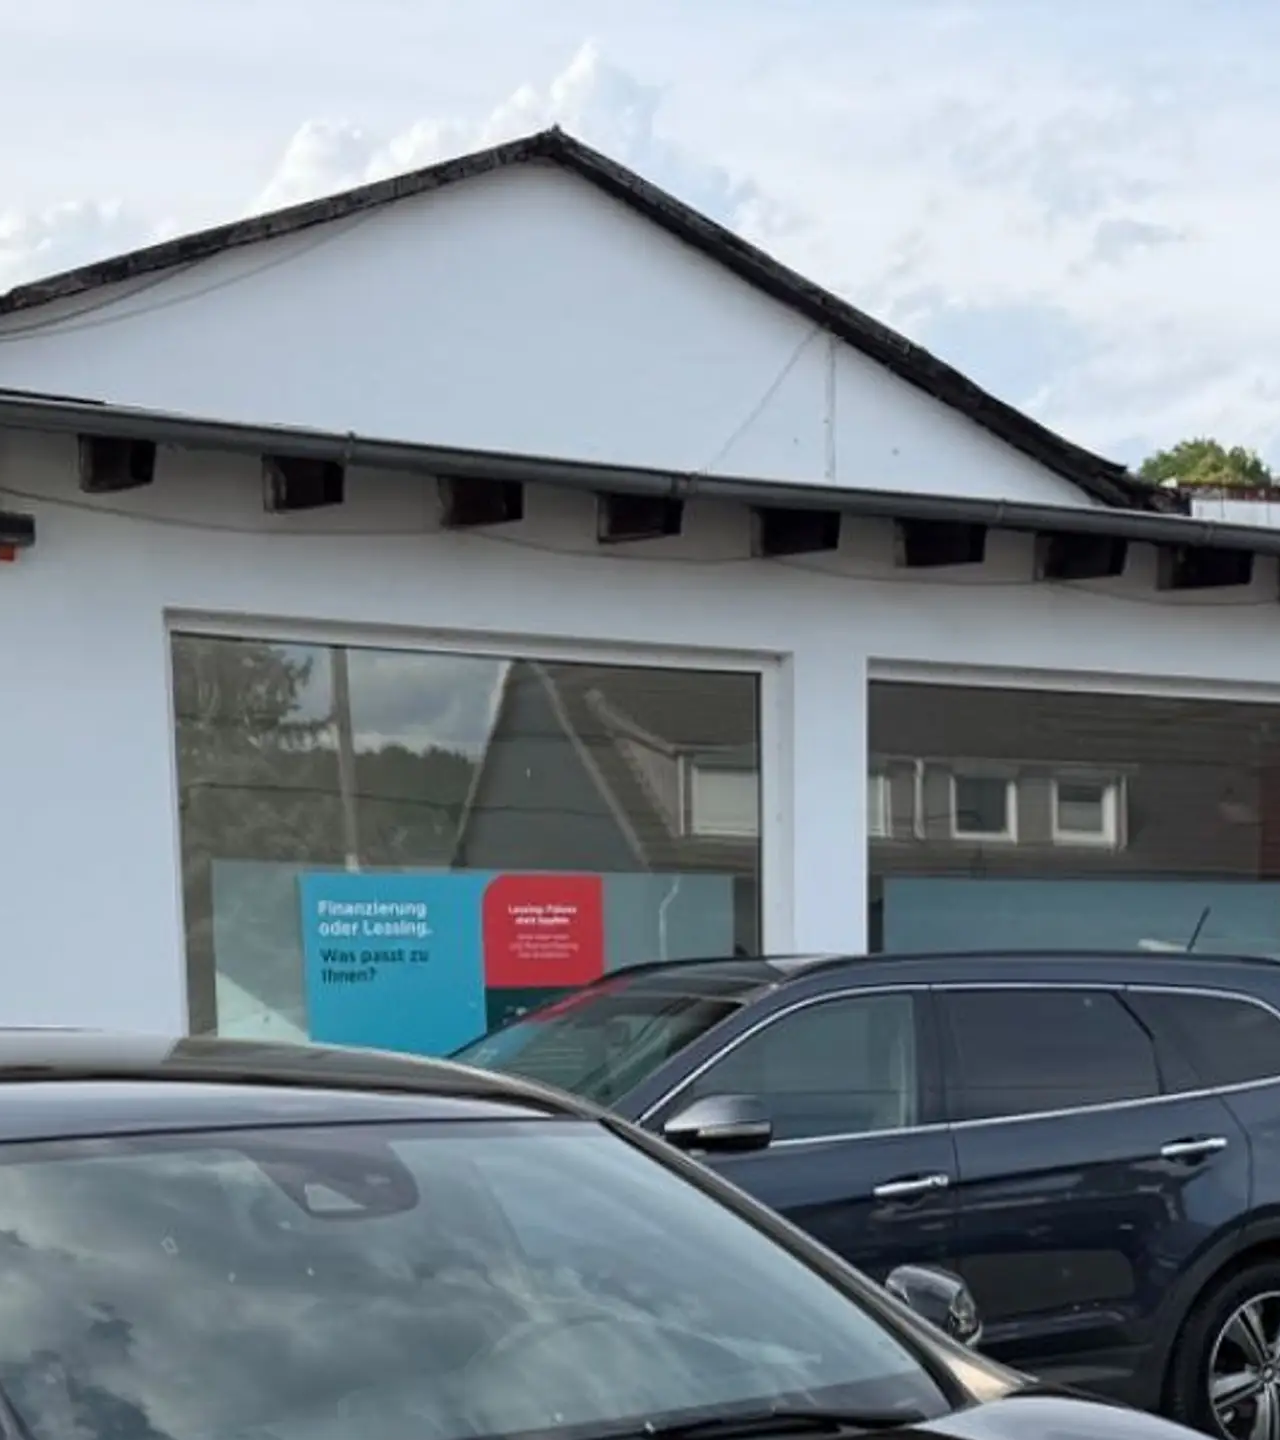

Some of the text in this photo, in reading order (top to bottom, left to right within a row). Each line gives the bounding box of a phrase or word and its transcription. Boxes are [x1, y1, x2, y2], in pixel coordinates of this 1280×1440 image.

[317, 899, 427, 919] Finanzierung
[318, 919, 432, 938] oder Leasing.
[320, 948, 429, 965] Was passt zu
[321, 966, 377, 985] Ihnen?
